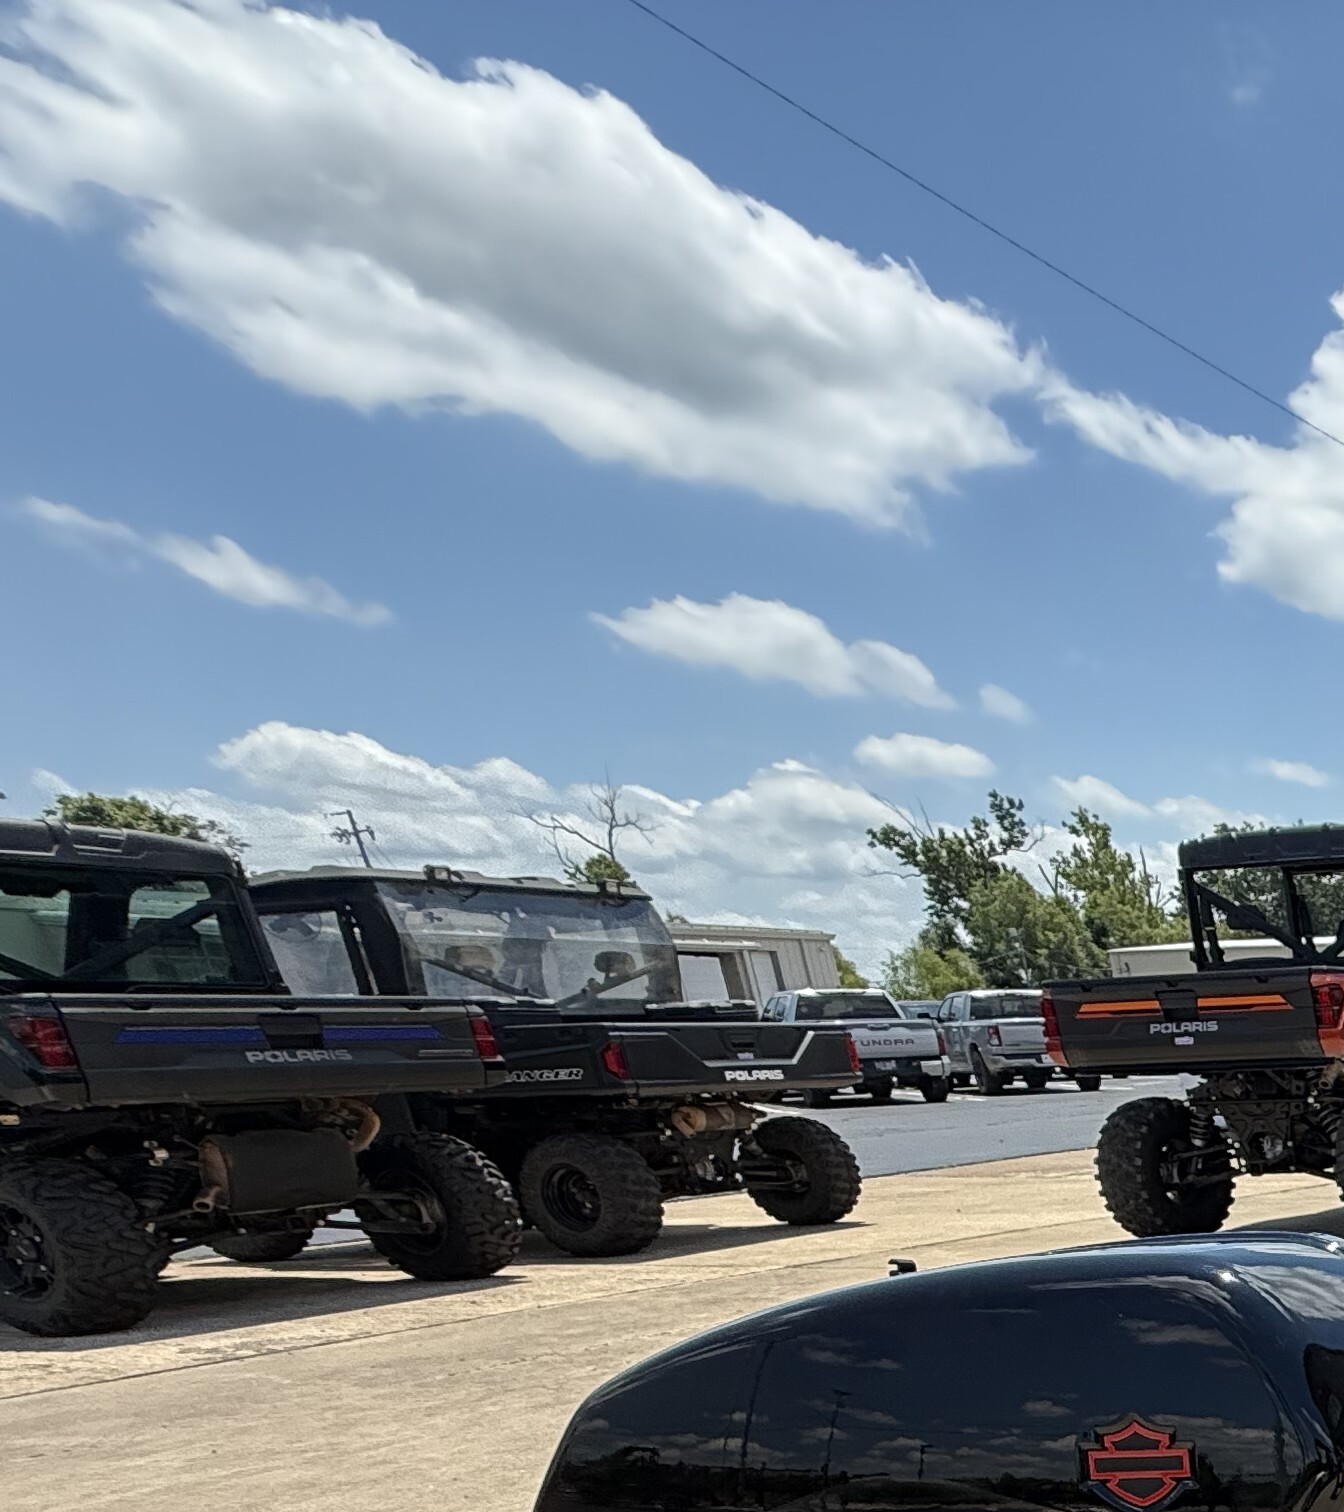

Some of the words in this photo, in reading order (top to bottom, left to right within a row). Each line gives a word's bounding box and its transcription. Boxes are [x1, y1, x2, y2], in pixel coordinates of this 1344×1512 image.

[1149, 1020, 1219, 1034] POLARIS
[853, 1038, 915, 1047] UNDRA
[245, 1048, 353, 1063] POLARIS
[504, 1068, 584, 1083] ANGER
[723, 1069, 784, 1081] POLARIS
